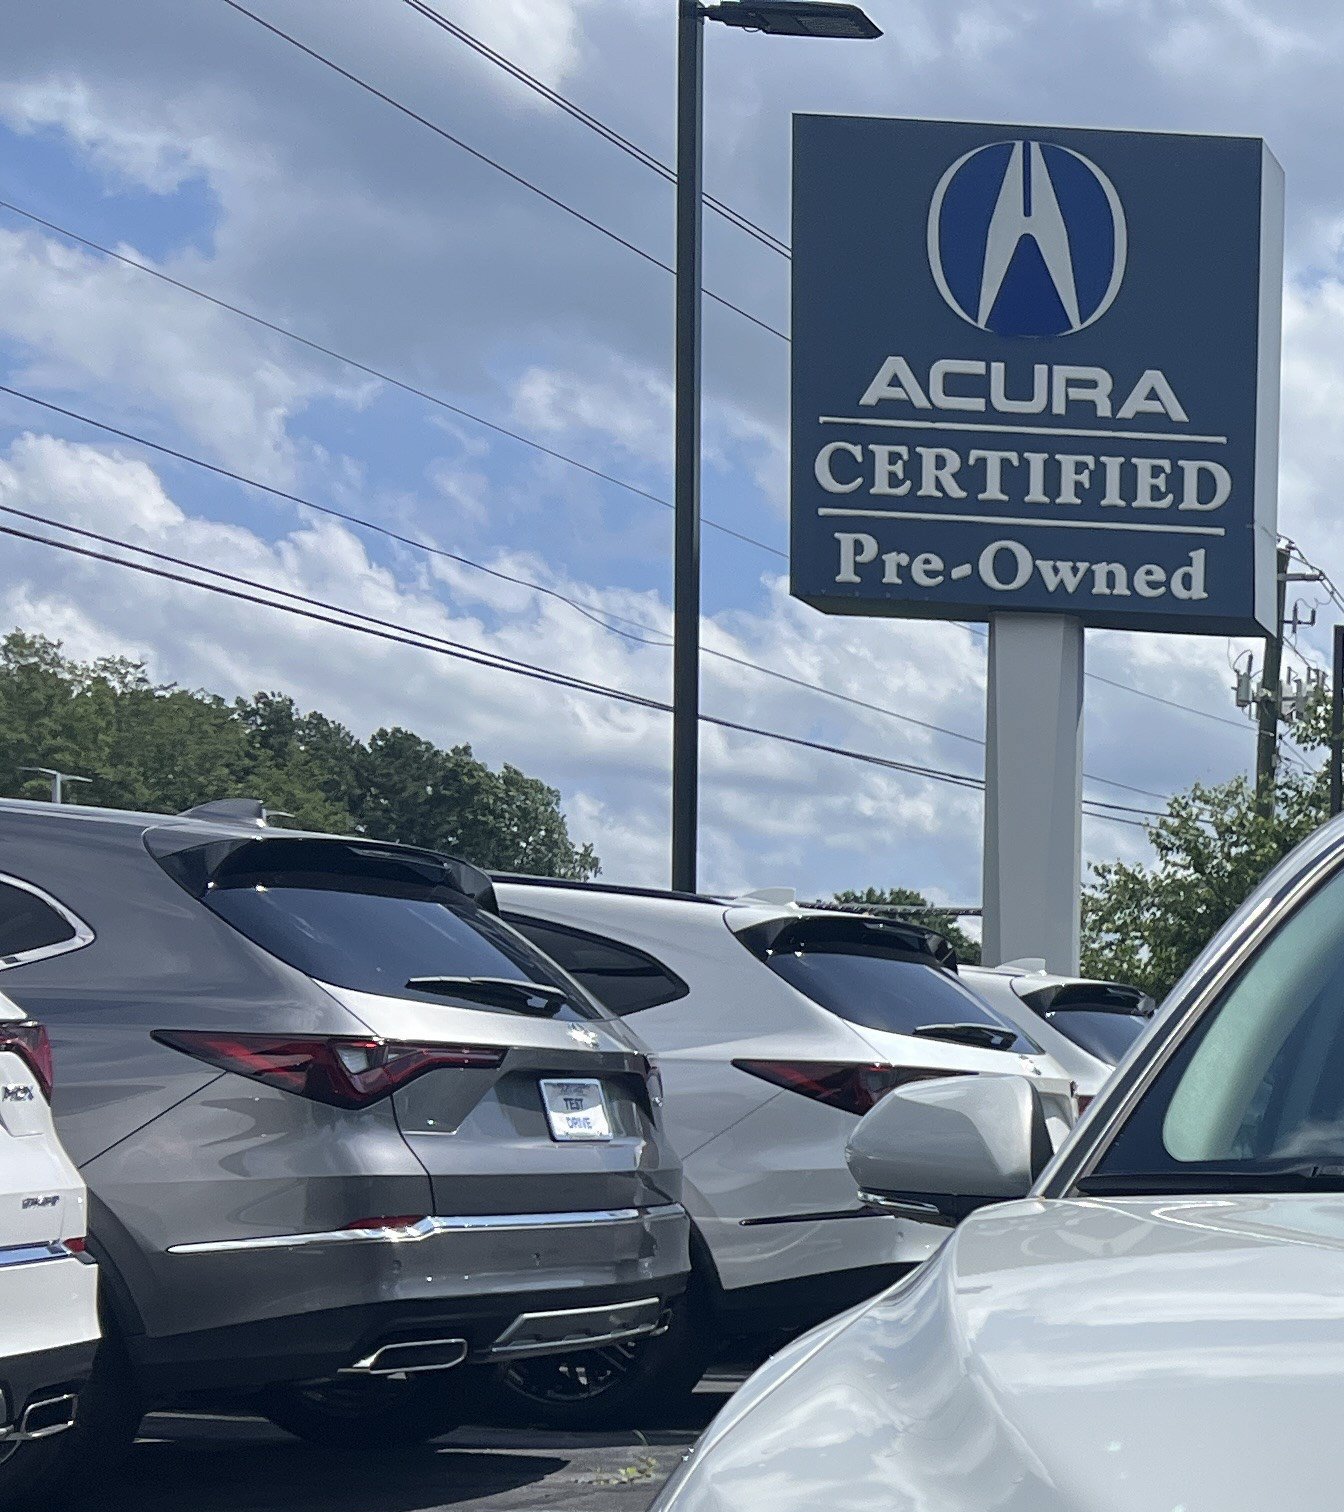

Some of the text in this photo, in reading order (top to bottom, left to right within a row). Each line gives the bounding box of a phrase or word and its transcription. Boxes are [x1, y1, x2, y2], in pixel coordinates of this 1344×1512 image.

[858, 355, 1190, 423] ACURA
[813, 441, 1232, 512] CERTIFIED
[833, 531, 1209, 601] Pre-Owned
[563, 1097, 584, 1111] TEST
